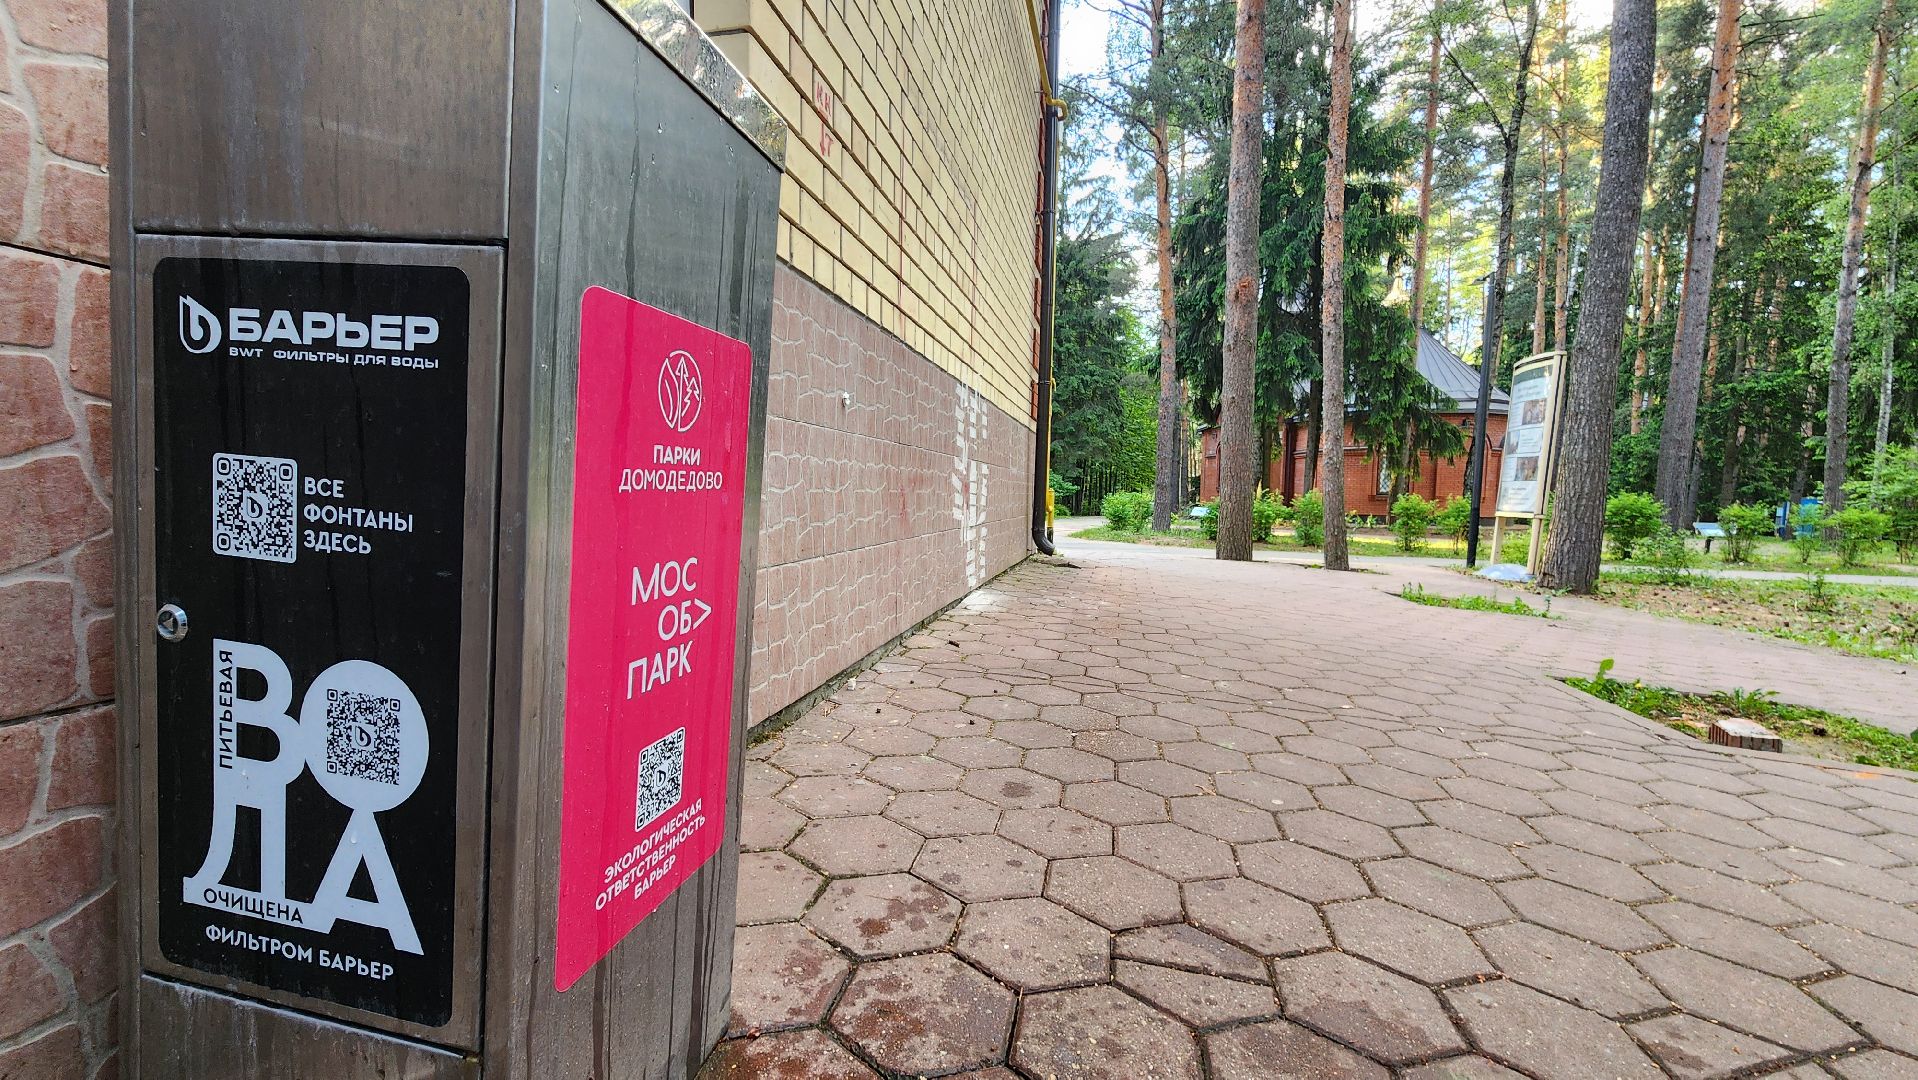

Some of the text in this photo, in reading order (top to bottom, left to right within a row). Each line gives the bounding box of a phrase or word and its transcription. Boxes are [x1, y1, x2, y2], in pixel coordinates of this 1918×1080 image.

[228, 307, 440, 351] БАРЬЕР
[229, 347, 439, 370] BWT ФИЛЬТРЫ ДЛЯ ВОДЫ
[653, 444, 701, 466] ПАРКИ
[303, 476, 345, 499] ВСЕ
[618, 468, 723, 493] ДОМОДЕДОВО
[303, 502, 414, 533] ФОНТАНЫ
[303, 529, 372, 555] ЗДЕСЬ
[631, 556, 698, 606] МОС
[626, 640, 694, 700] ПАРК
[218, 650, 233, 770] ПИТЬЕВАЯ
[595, 814, 706, 911] ОТВЕТСТВЕННОСТЬ
[604, 797, 702, 884] ЭКОЛОГИЧЕСКАЯ
[634, 854, 677, 900] БАРЬЕР
[203, 887, 304, 925] ОЧИЩЕНА
[205, 923, 394, 981] ФИЛЬТРОМ БАРЬЕР
